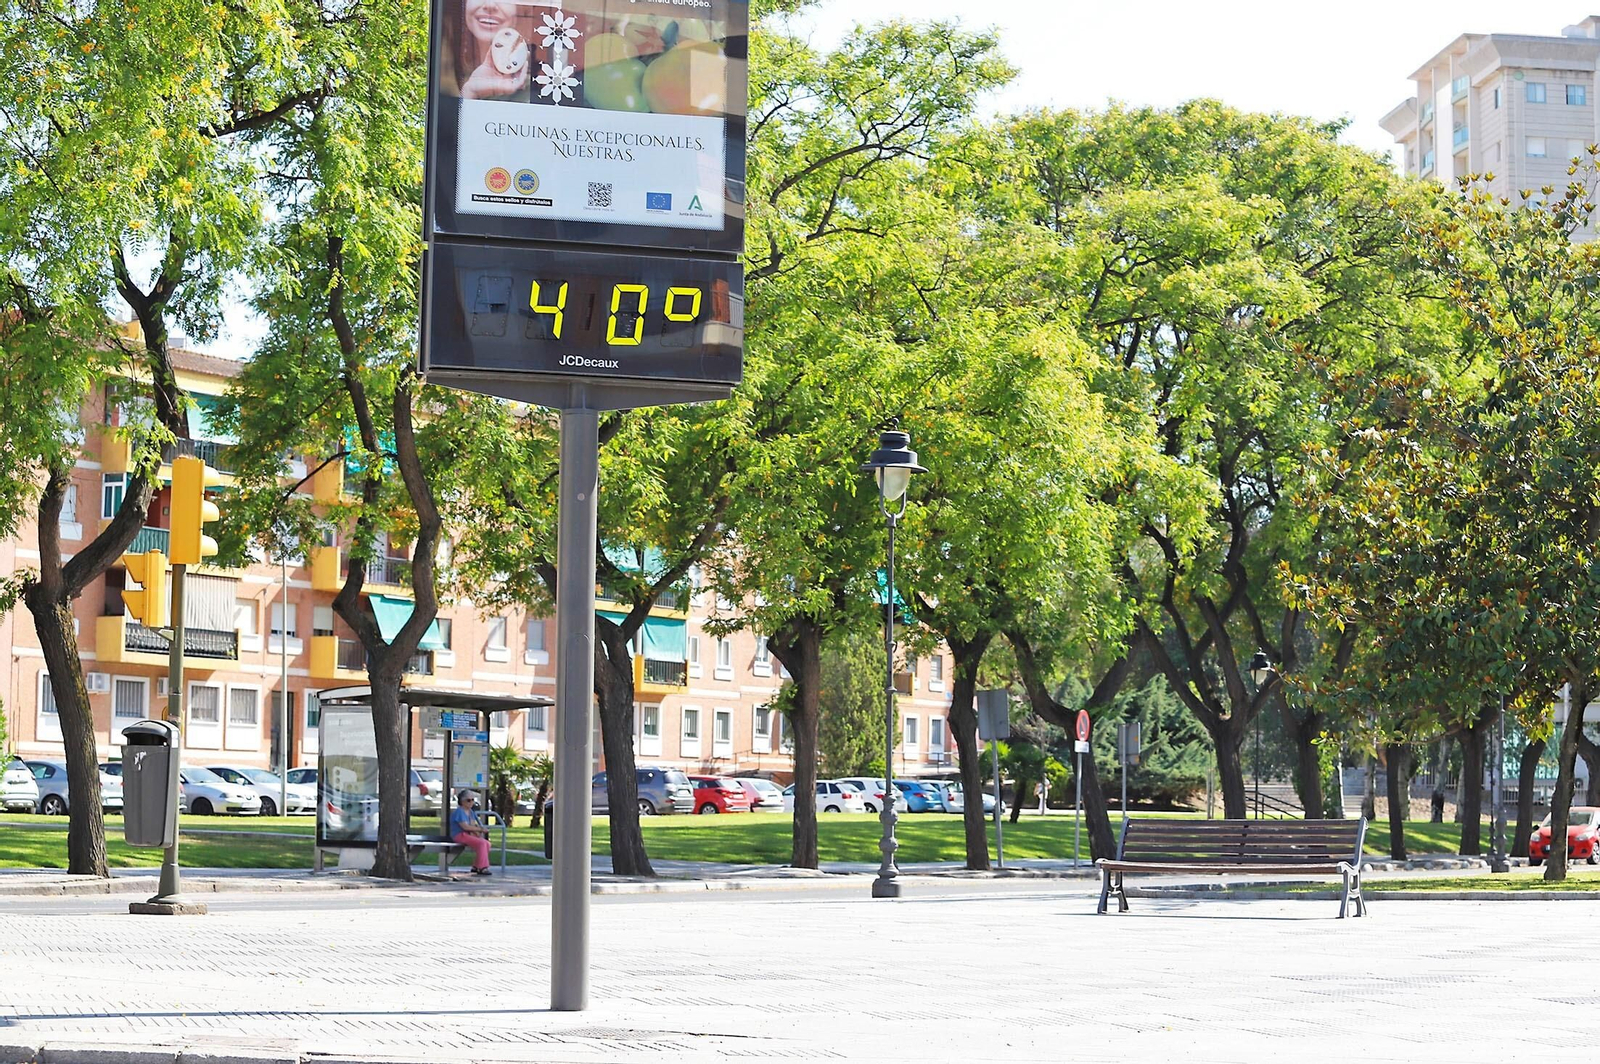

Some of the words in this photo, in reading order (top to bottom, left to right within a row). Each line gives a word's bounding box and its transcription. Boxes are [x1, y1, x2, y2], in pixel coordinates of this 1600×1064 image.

[484, 122, 570, 142] GENUINAS.
[576, 129, 704, 150] EXCEPCIONALES.
[552, 140, 636, 162] NUESTRAS.
[558, 354, 619, 369] JCDecaux
